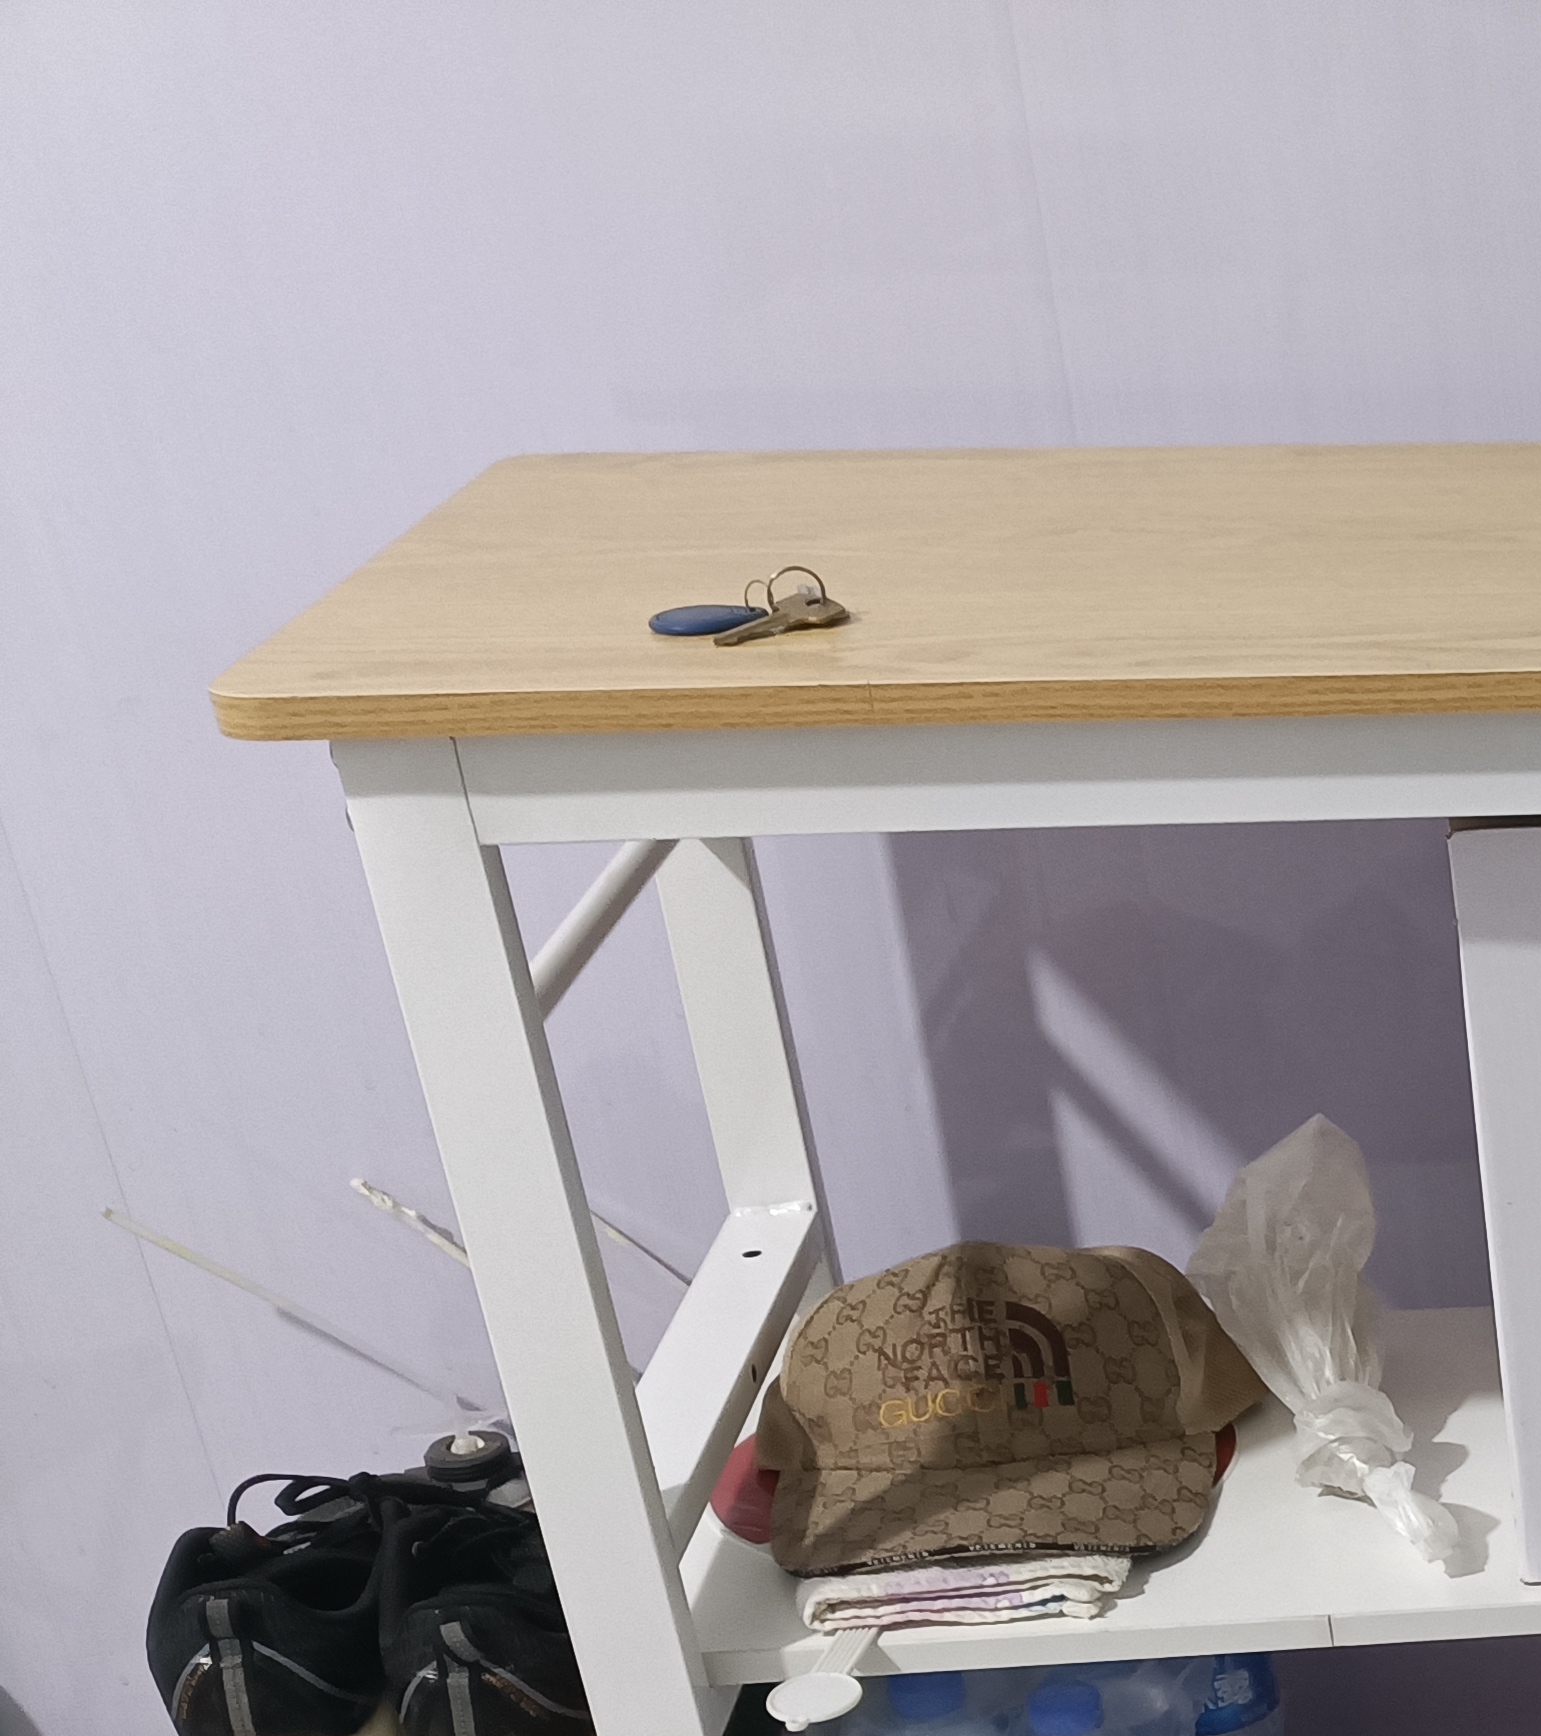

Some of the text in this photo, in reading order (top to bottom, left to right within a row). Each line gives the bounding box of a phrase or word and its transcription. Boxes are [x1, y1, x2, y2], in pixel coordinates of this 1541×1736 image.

[927, 1298, 998, 1329] THE
[876, 1325, 1005, 1372] NORTH
[901, 1354, 1006, 1392] FACE
